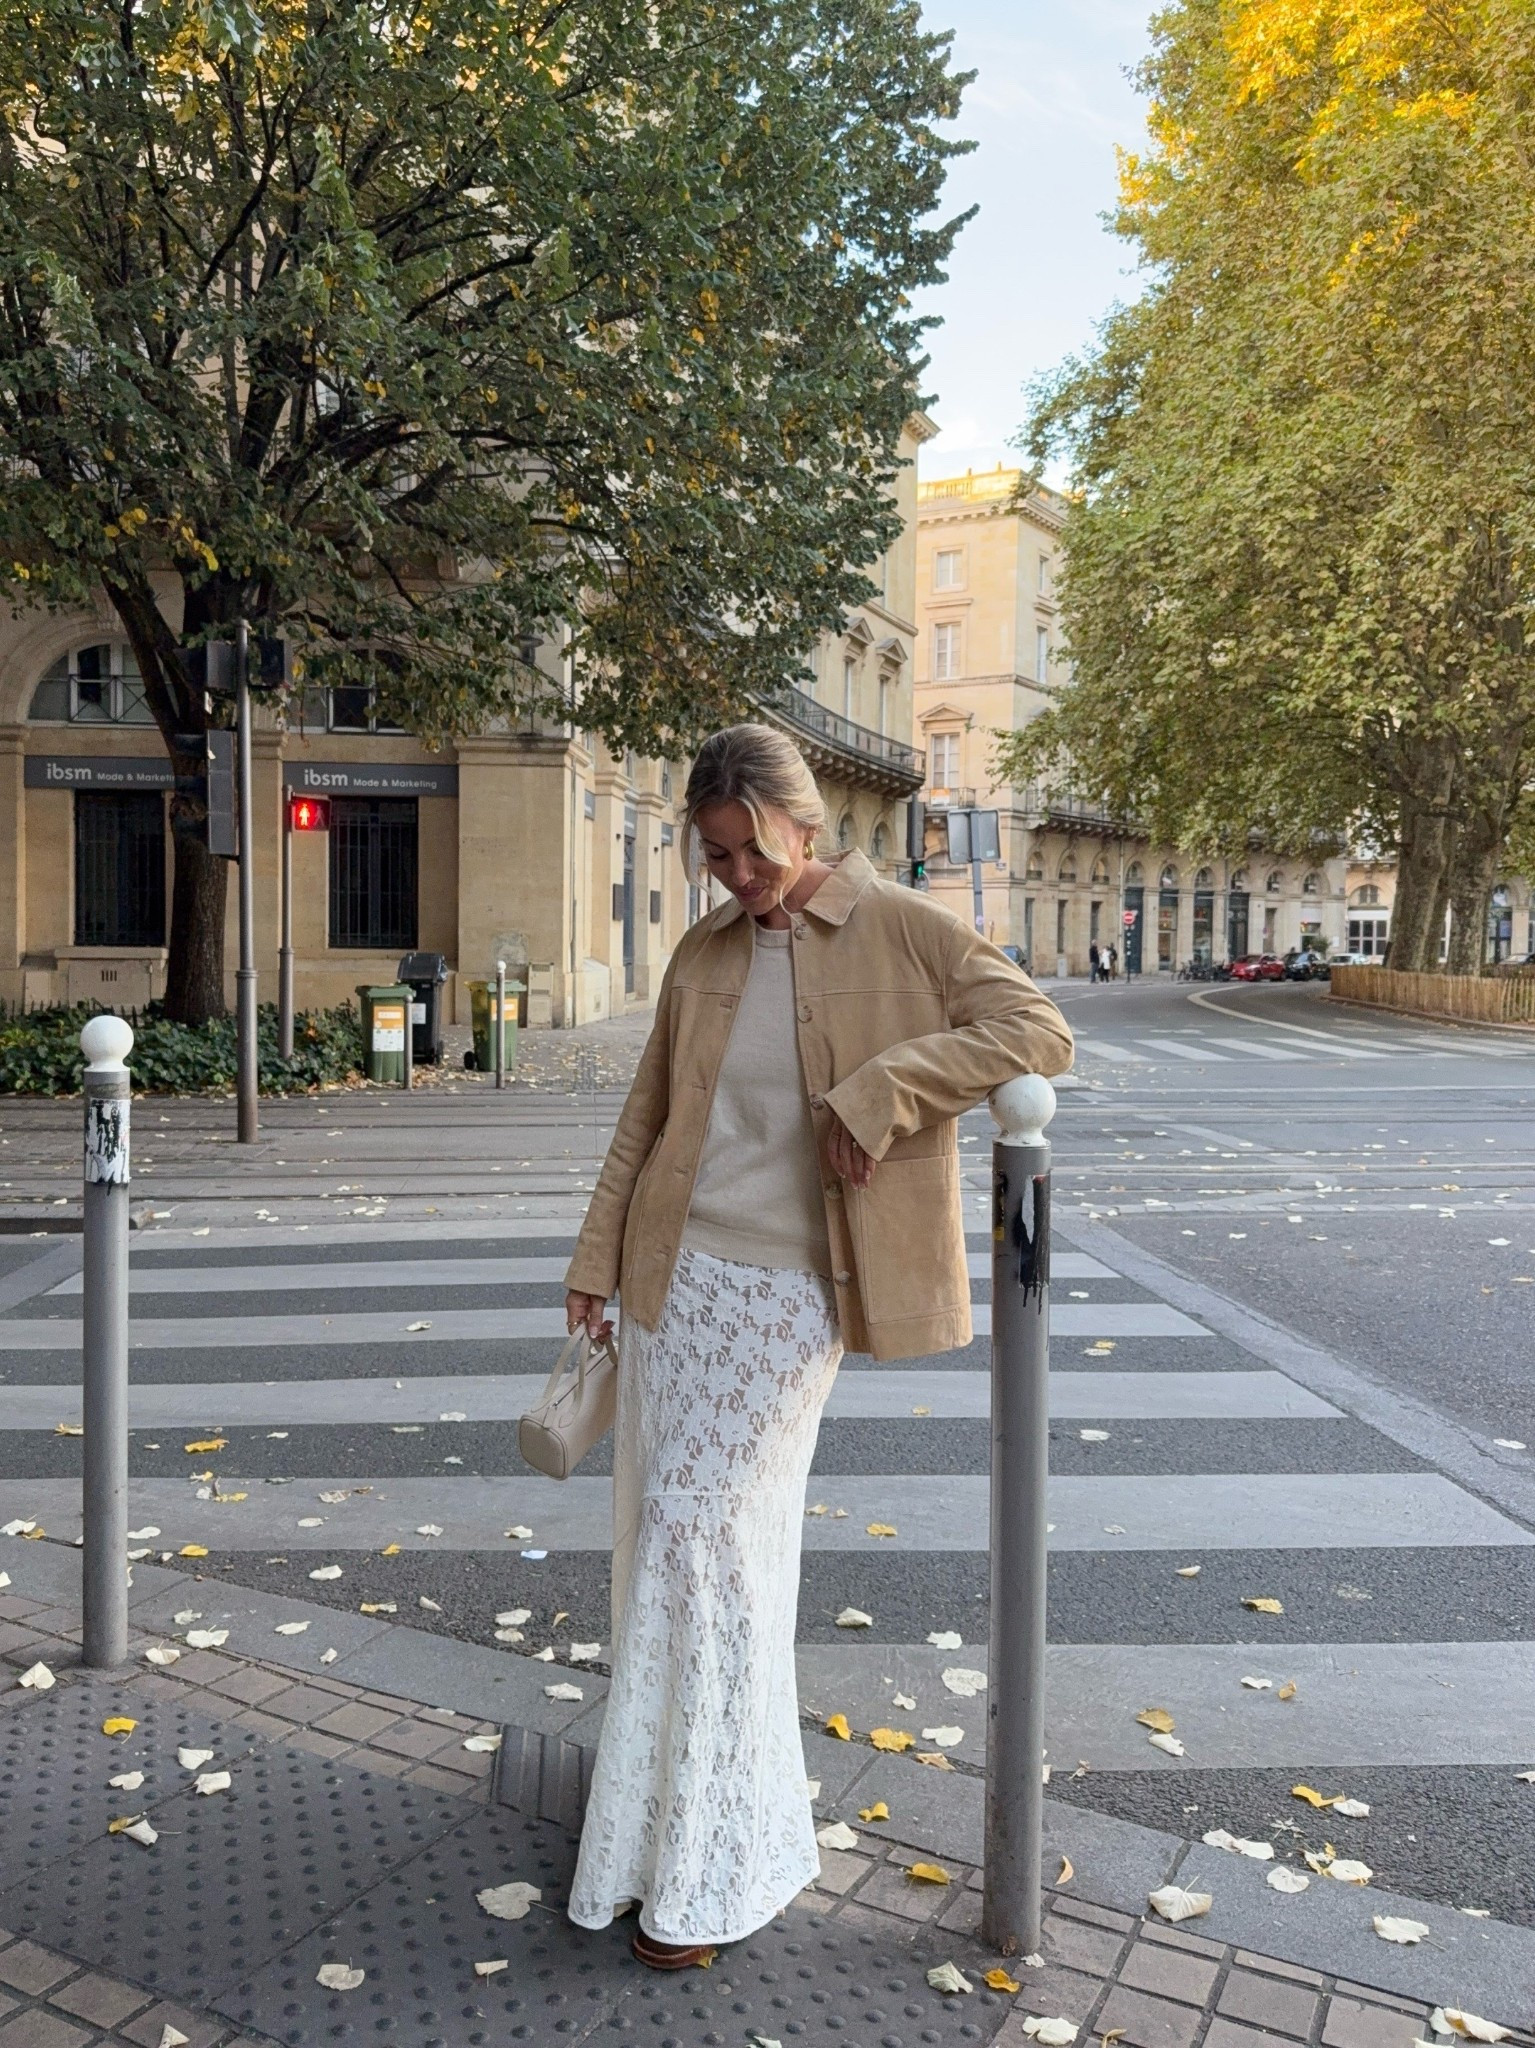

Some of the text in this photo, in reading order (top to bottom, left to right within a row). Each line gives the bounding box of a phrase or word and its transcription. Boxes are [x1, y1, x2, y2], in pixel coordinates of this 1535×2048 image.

[46, 763, 92, 780] ibsm
[97, 773, 123, 781] Mode
[304, 769, 437, 789] ibsm Mode & Marketing
